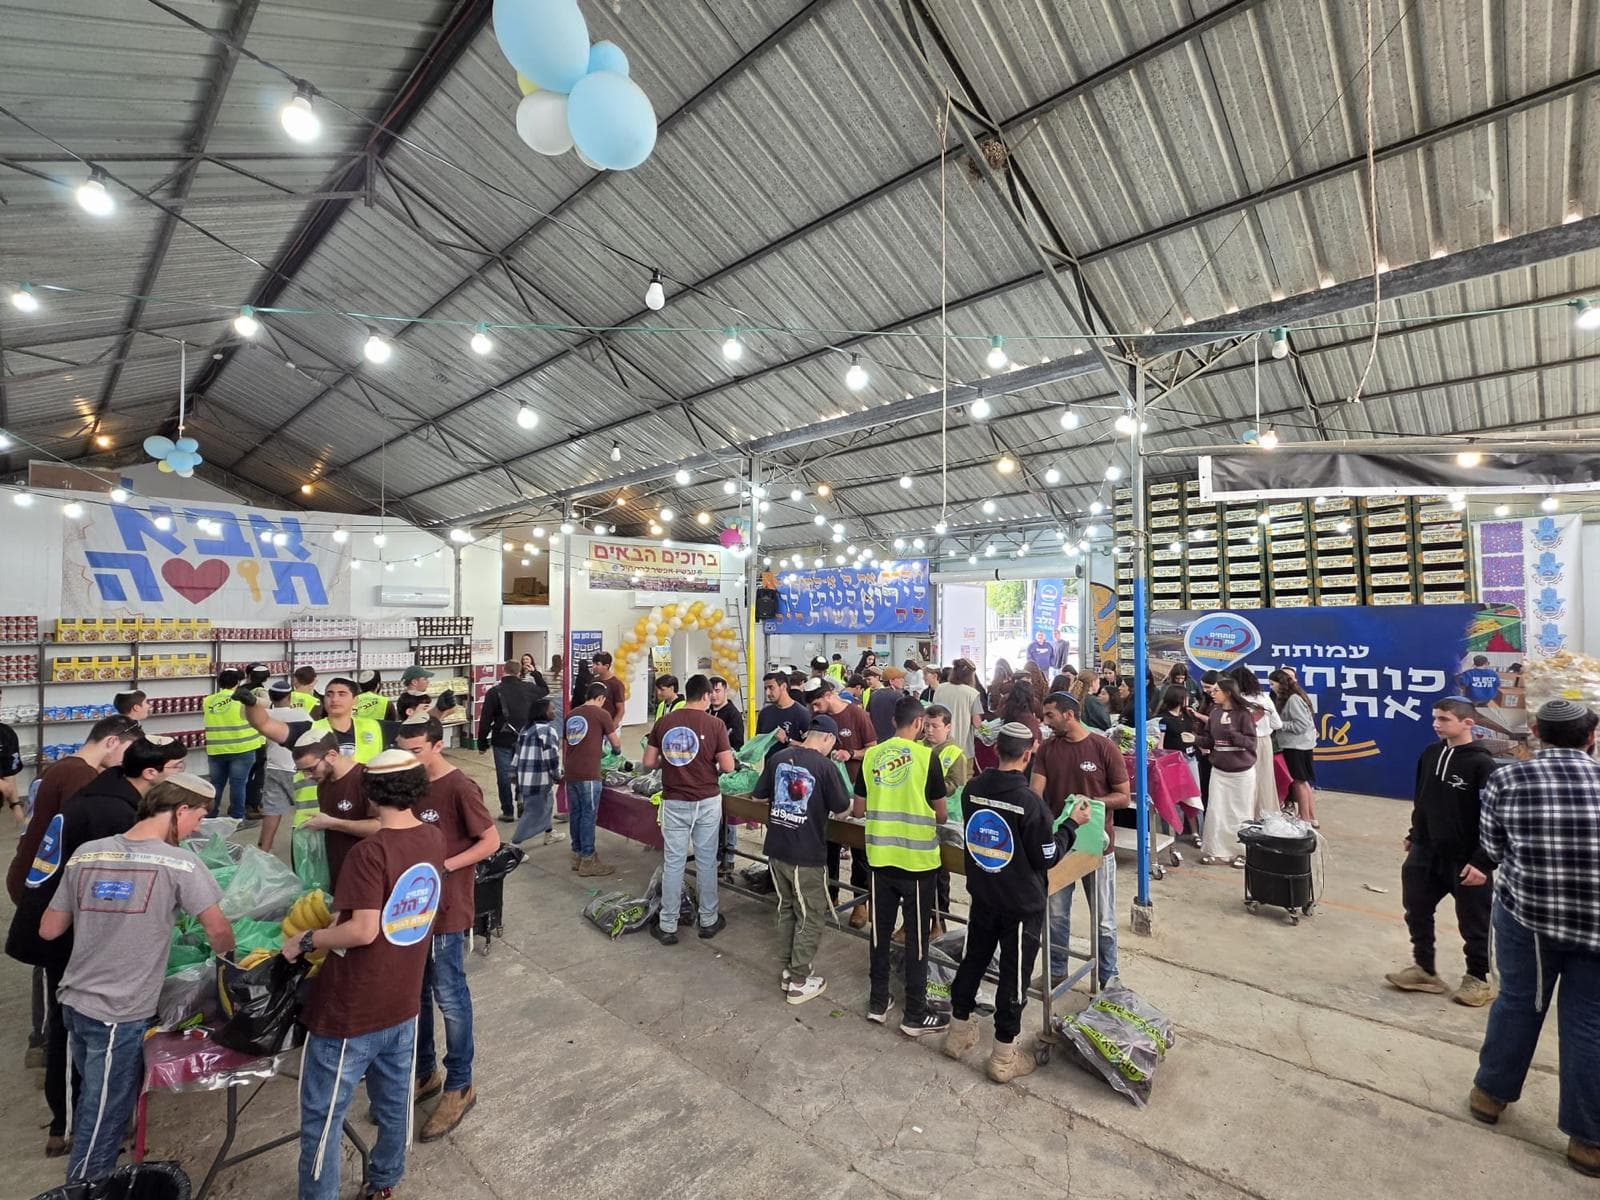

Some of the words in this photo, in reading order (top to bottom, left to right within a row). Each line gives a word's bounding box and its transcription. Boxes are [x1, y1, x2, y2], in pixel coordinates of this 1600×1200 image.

[593, 544, 657, 562] הבאים
[661, 549, 718, 567] ברוכים
[1194, 636, 1224, 648] הלב
[1271, 644, 1370, 659] עמותת
[1340, 693, 1422, 722] את
[392, 898, 417, 917] הלב
